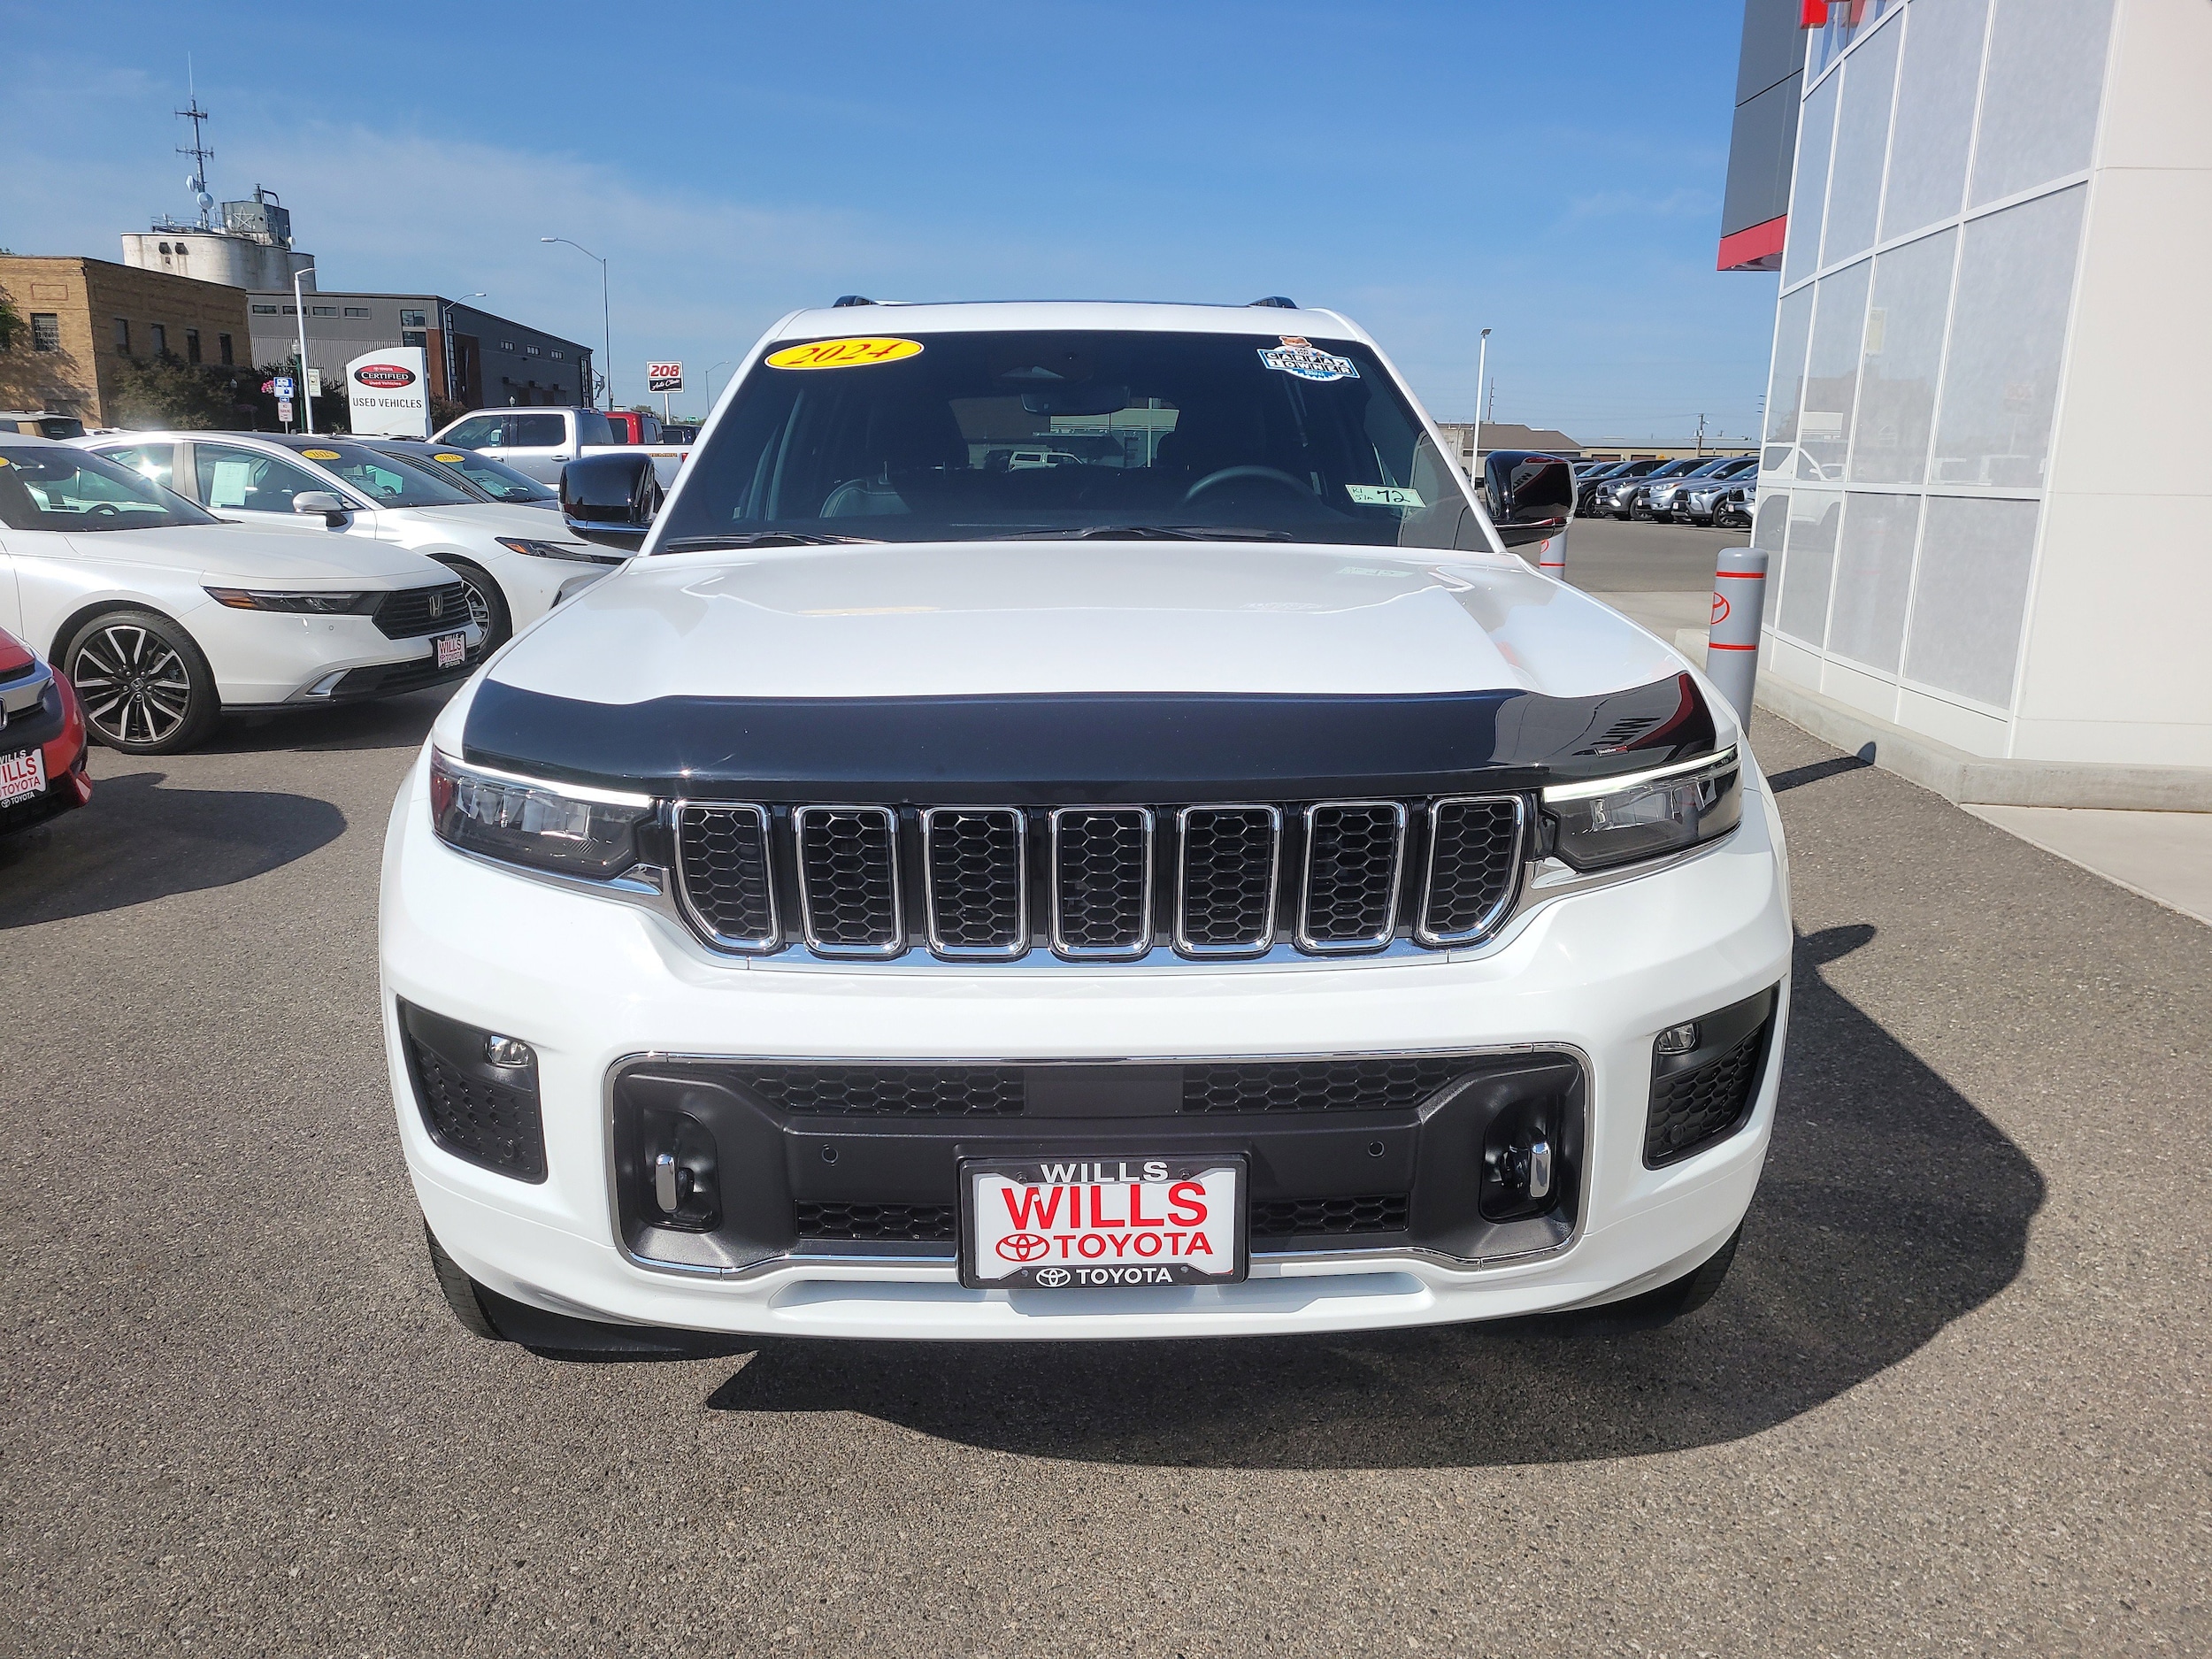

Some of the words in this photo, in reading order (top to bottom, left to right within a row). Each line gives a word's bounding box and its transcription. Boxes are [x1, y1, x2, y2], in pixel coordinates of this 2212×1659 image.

[785, 342, 903, 365] 2024
[1265, 352, 1348, 367] CARFAX
[650, 365, 680, 377] 208
[352, 397, 376, 407] USED
[378, 398, 422, 409] VEHICLES
[1377, 489, 1411, 503] 72
[439, 639, 462, 655] WILLS
[1, 757, 36, 783] ILLS
[2, 777, 41, 796] TOYOTA
[11, 791, 35, 804] TOYOTA
[1041, 1161, 1169, 1184] WILLS
[1001, 1181, 1209, 1231] WILLS
[1053, 1232, 1214, 1259] TOYOTA
[1076, 1267, 1173, 1285] TOYOTA
